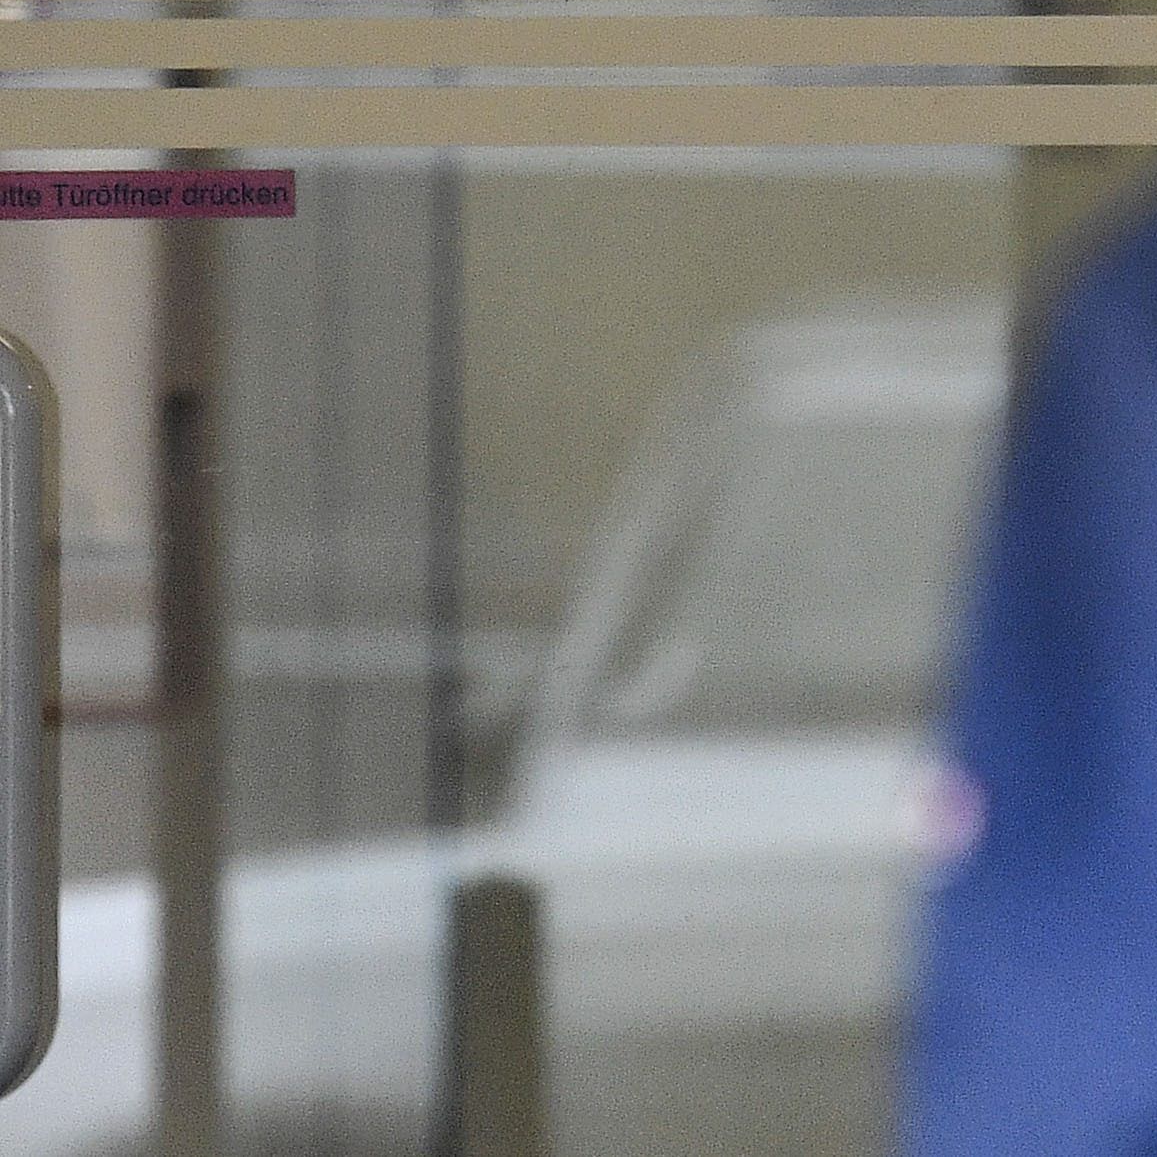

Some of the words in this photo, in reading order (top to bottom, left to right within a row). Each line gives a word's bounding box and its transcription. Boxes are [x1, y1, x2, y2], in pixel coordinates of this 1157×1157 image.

[0, 184, 42, 207] itte
[51, 183, 171, 207] Türöffner
[181, 182, 289, 207] drücken
